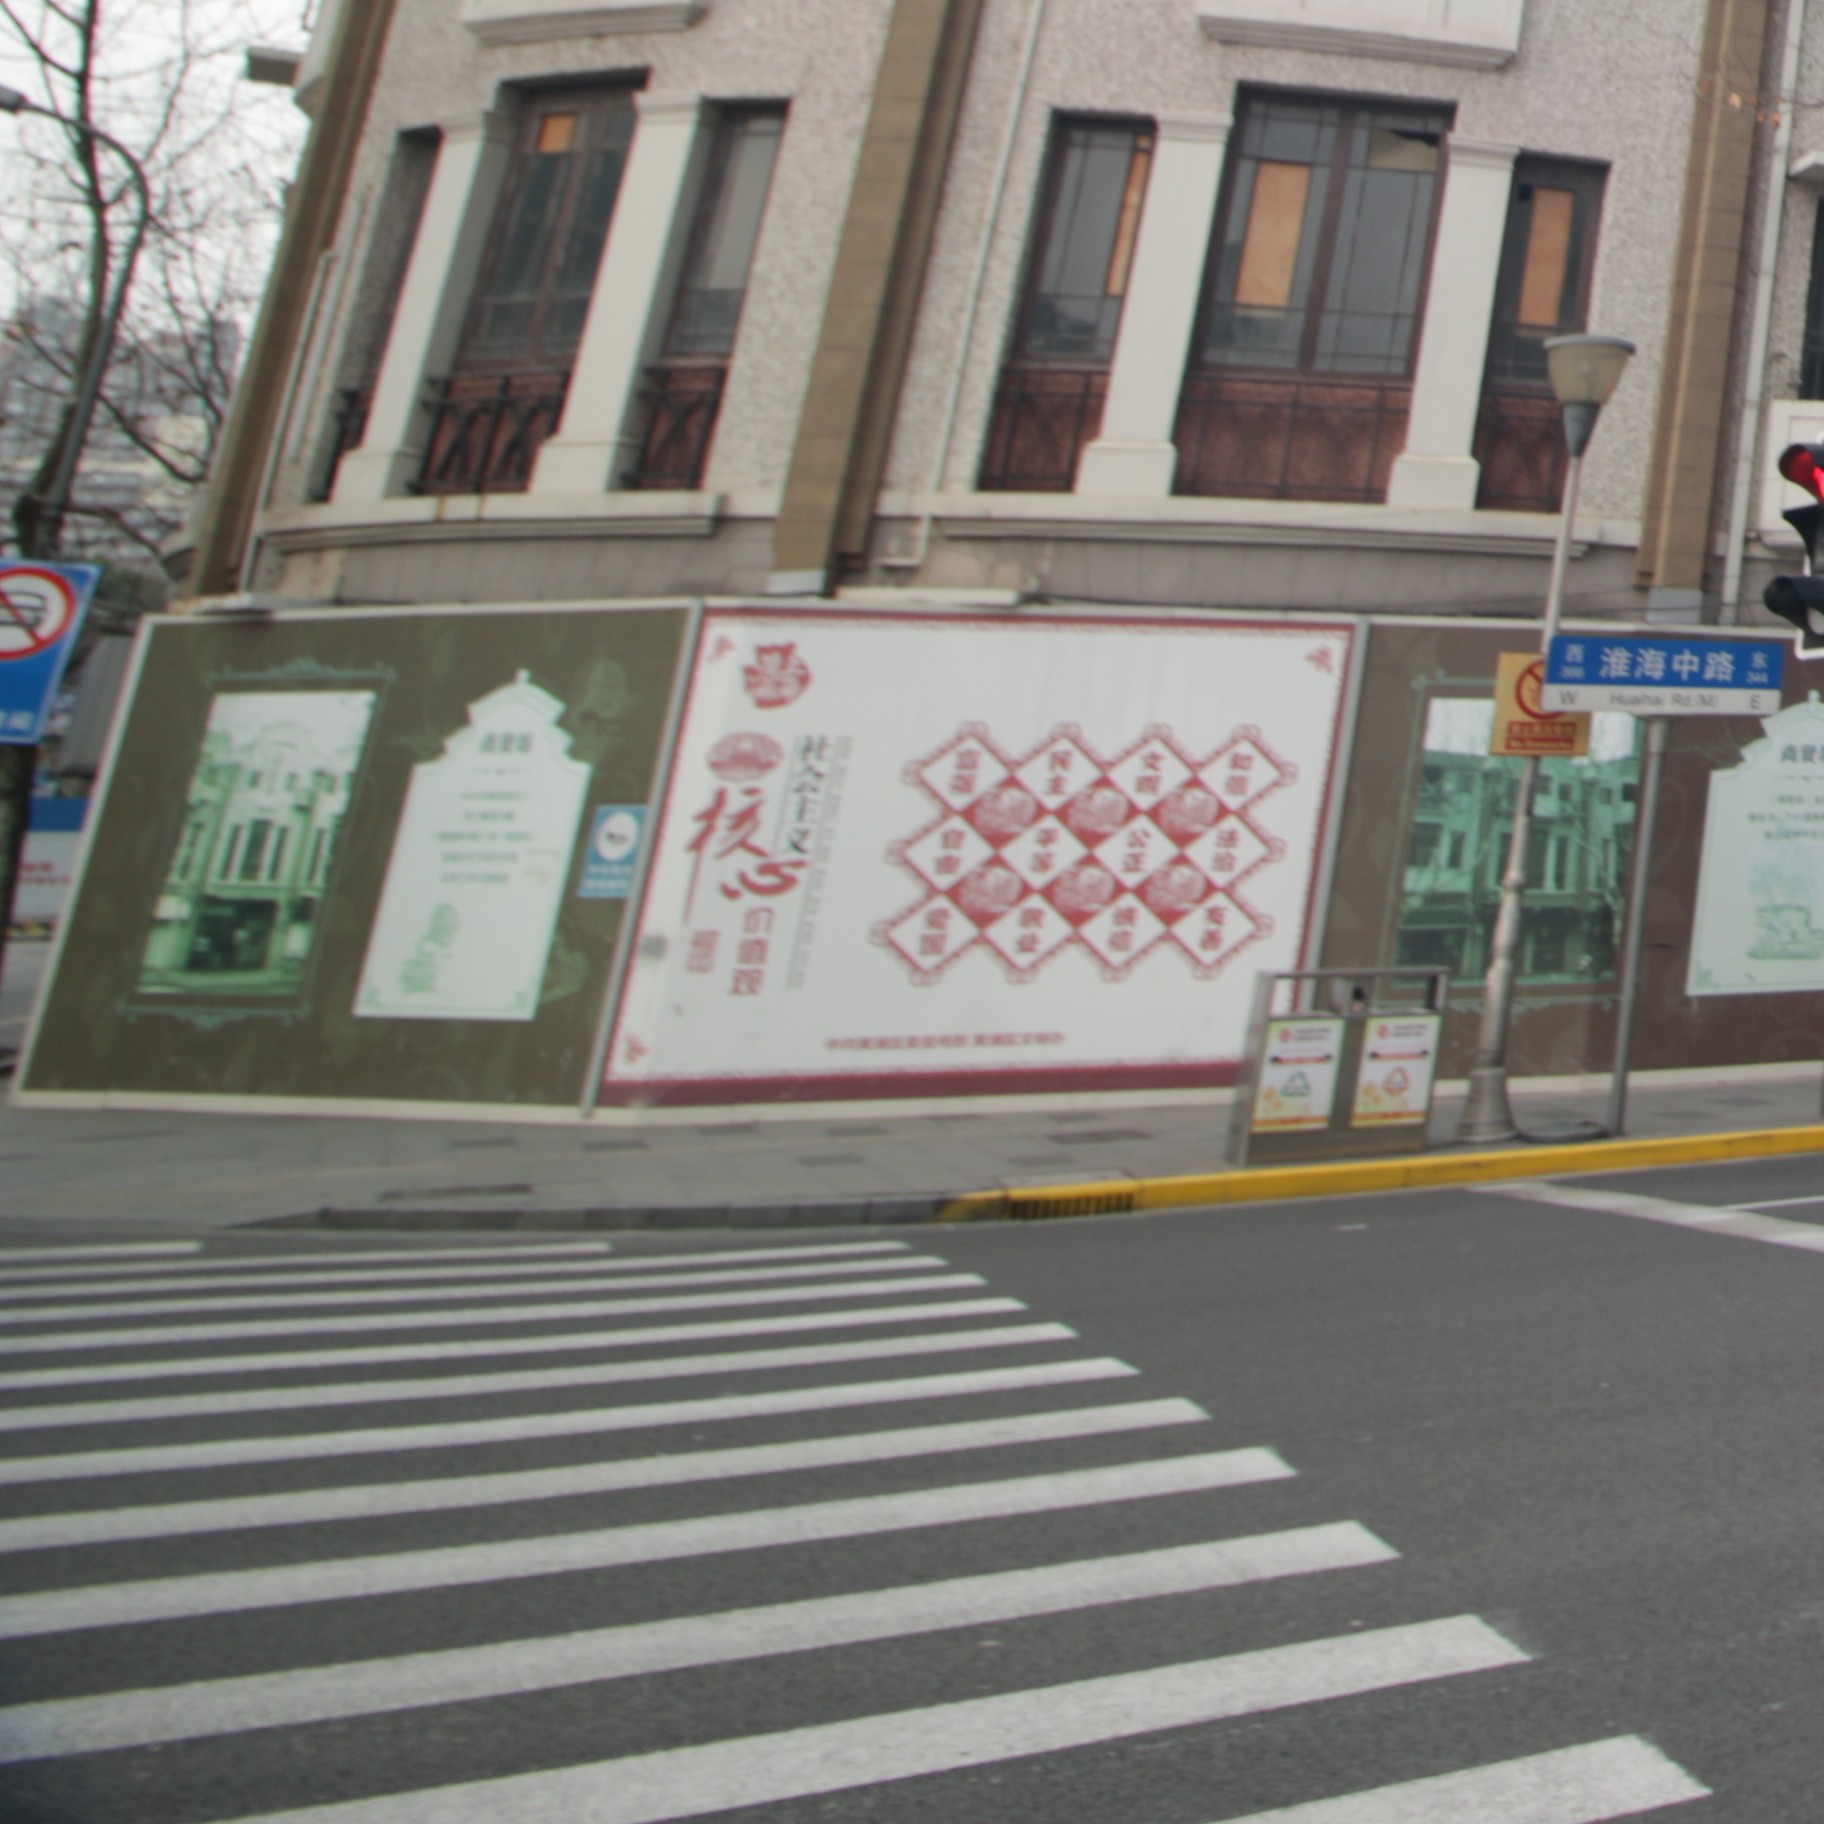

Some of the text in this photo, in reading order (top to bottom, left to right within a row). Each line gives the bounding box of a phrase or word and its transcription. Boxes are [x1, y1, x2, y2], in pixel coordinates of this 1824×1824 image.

[1565, 643, 1585, 662] 西
[1751, 651, 1768, 668] 东
[1598, 646, 1735, 682] 淮海中路
[1559, 691, 1579, 705] W
[1610, 692, 1664, 707] Huaihai
[1750, 695, 1760, 709] E
